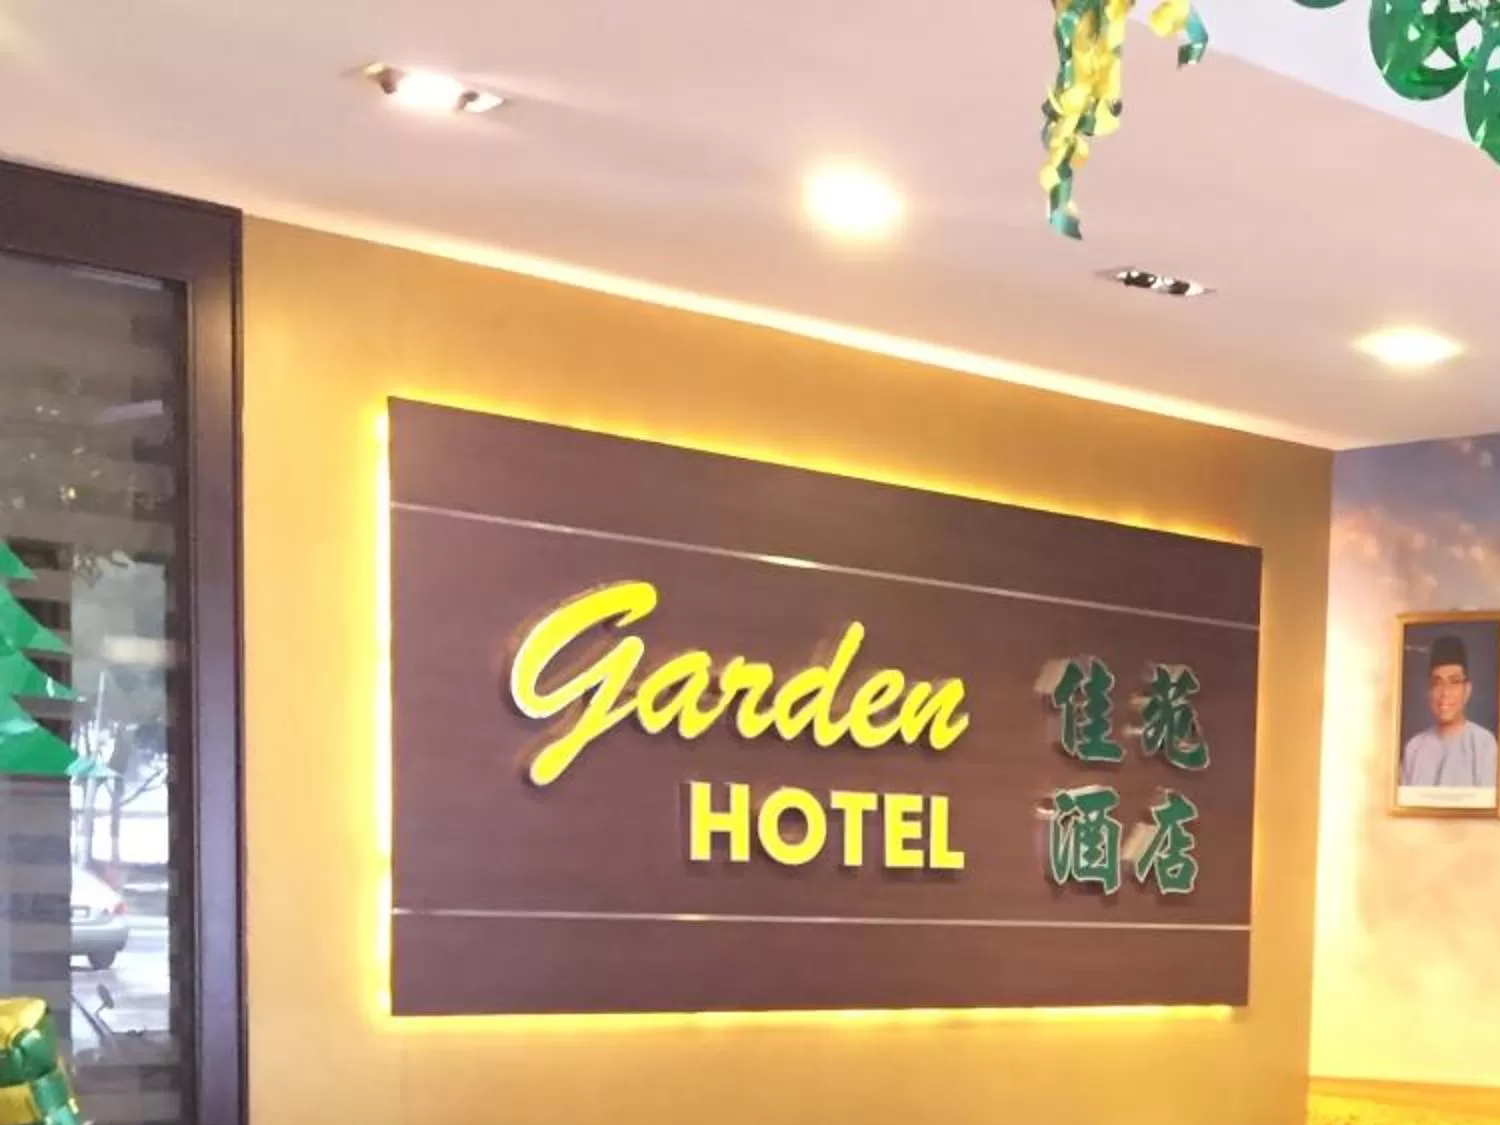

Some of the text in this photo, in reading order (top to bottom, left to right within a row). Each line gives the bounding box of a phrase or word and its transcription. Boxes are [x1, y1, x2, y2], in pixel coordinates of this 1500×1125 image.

[511, 581, 969, 786] Garden
[1052, 658, 1210, 770] 佳苑
[689, 781, 965, 869] HOTEL
[1052, 786, 1198, 895] 酒店
